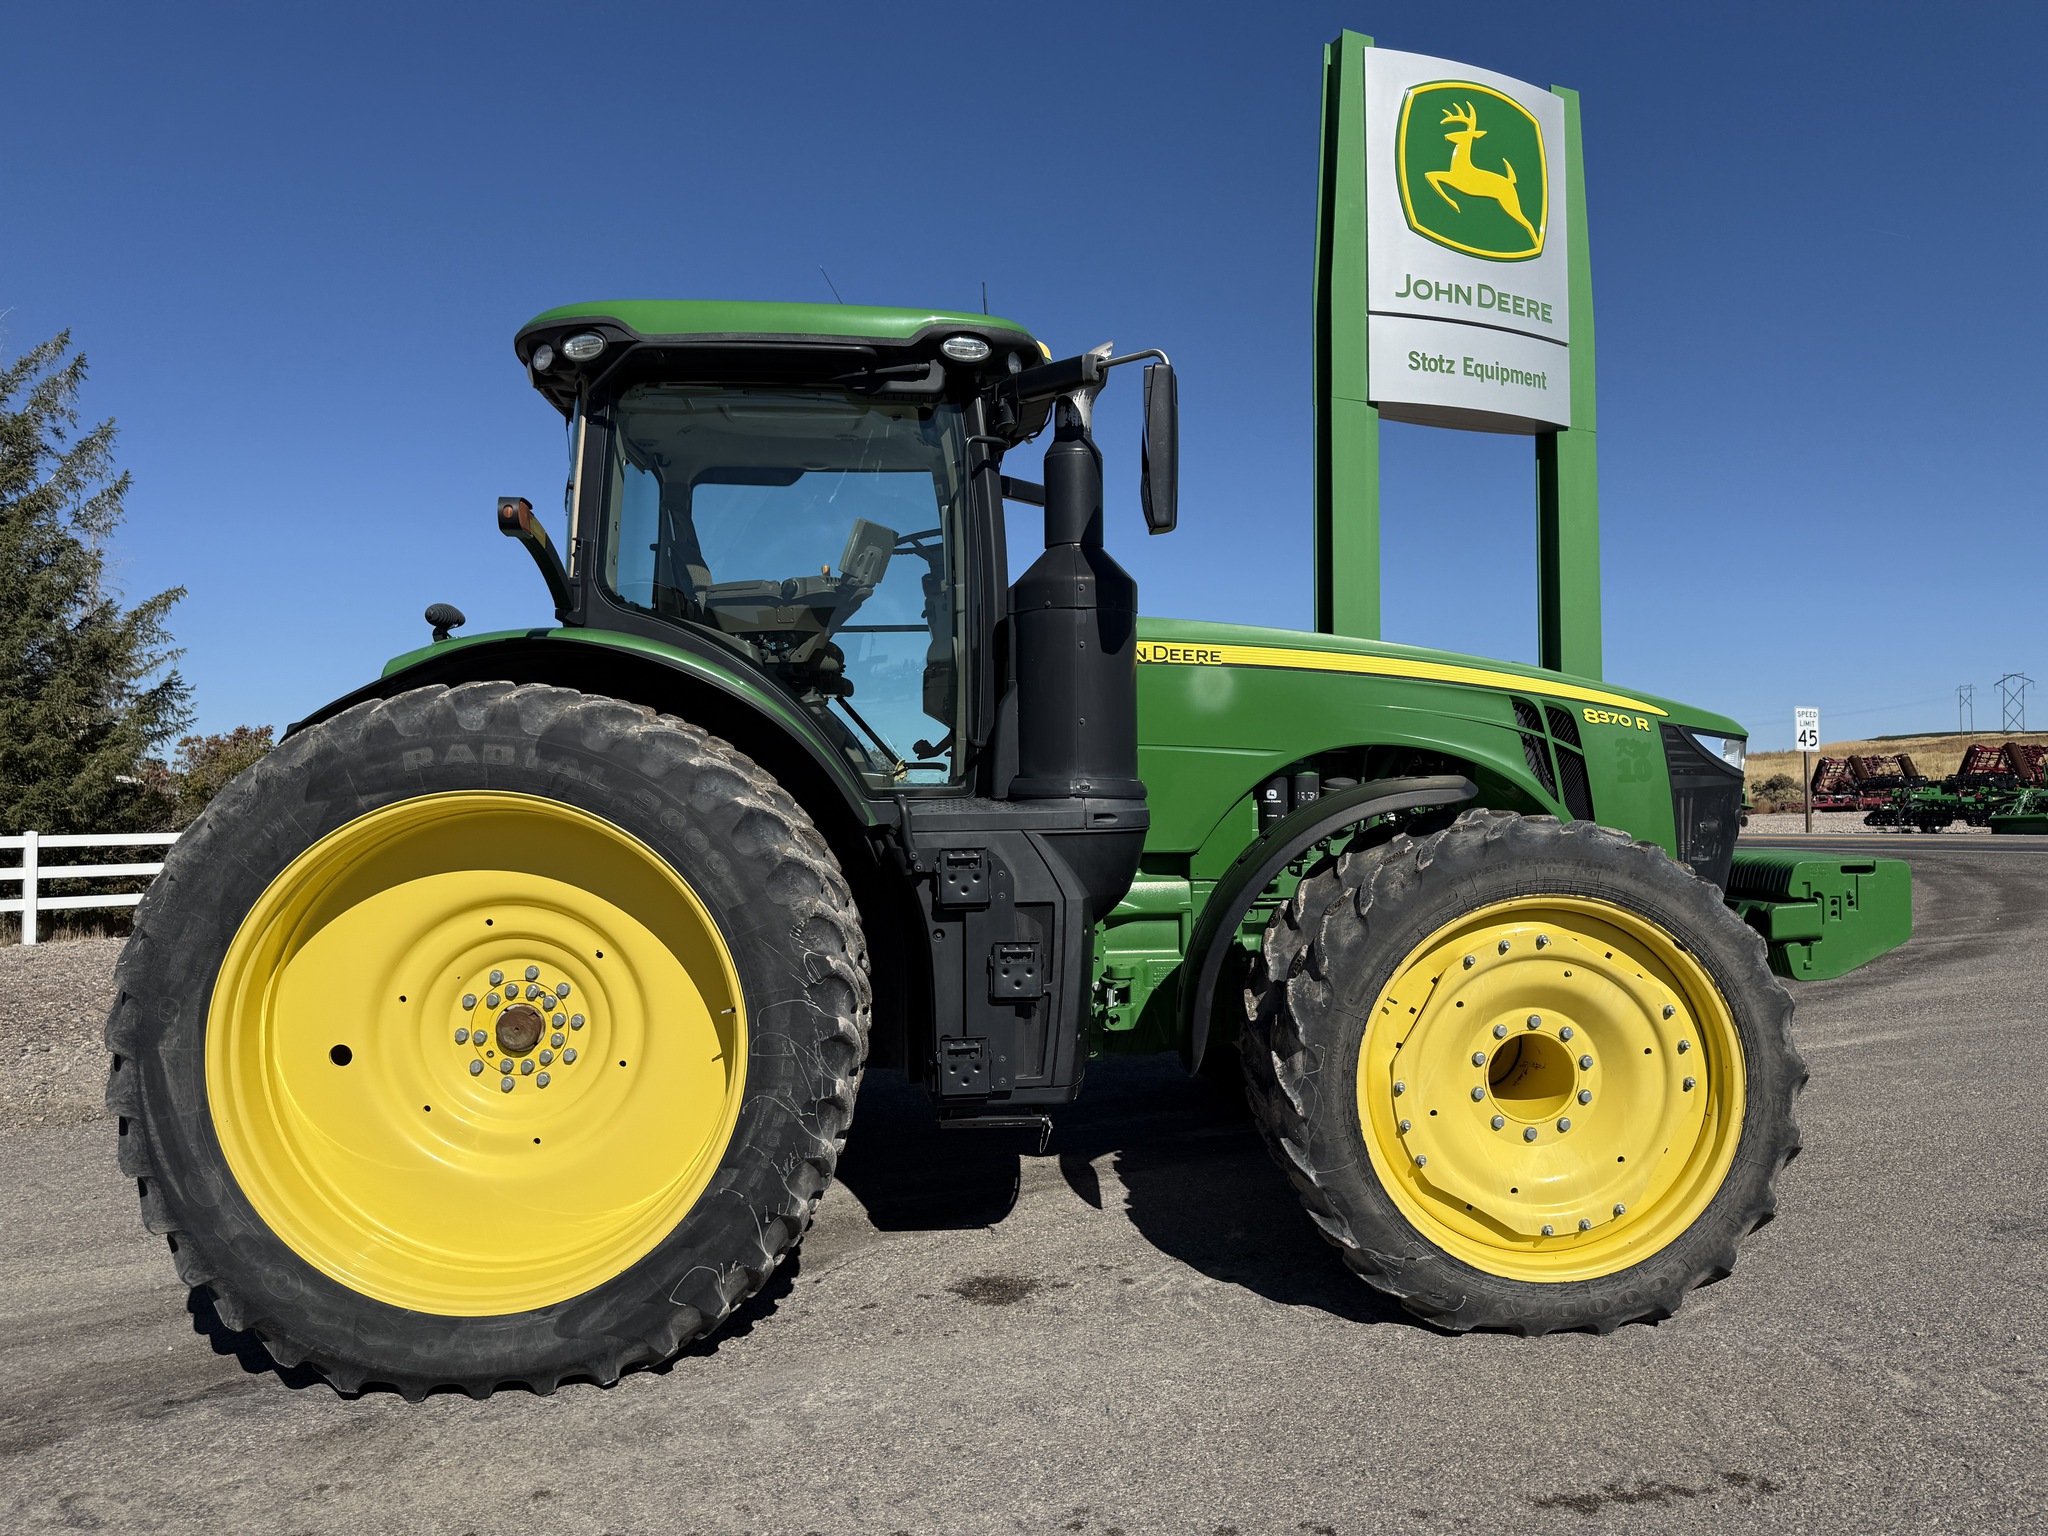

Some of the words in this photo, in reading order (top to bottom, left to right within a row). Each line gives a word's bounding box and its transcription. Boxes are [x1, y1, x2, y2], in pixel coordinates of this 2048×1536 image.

[1395, 273, 1472, 307] JOHN
[1477, 283, 1553, 324] DEERE
[1408, 350, 1455, 375] Stotz
[1463, 356, 1547, 390] Equipment
[1153, 646, 1222, 662] DEERE
[1582, 708, 1632, 727] 8370
[1635, 716, 1651, 732] R
[1797, 710, 1817, 718] SPEED
[1798, 729, 1818, 747] 45
[402, 743, 611, 793] RADIAL
[633, 787, 731, 877] 9000
